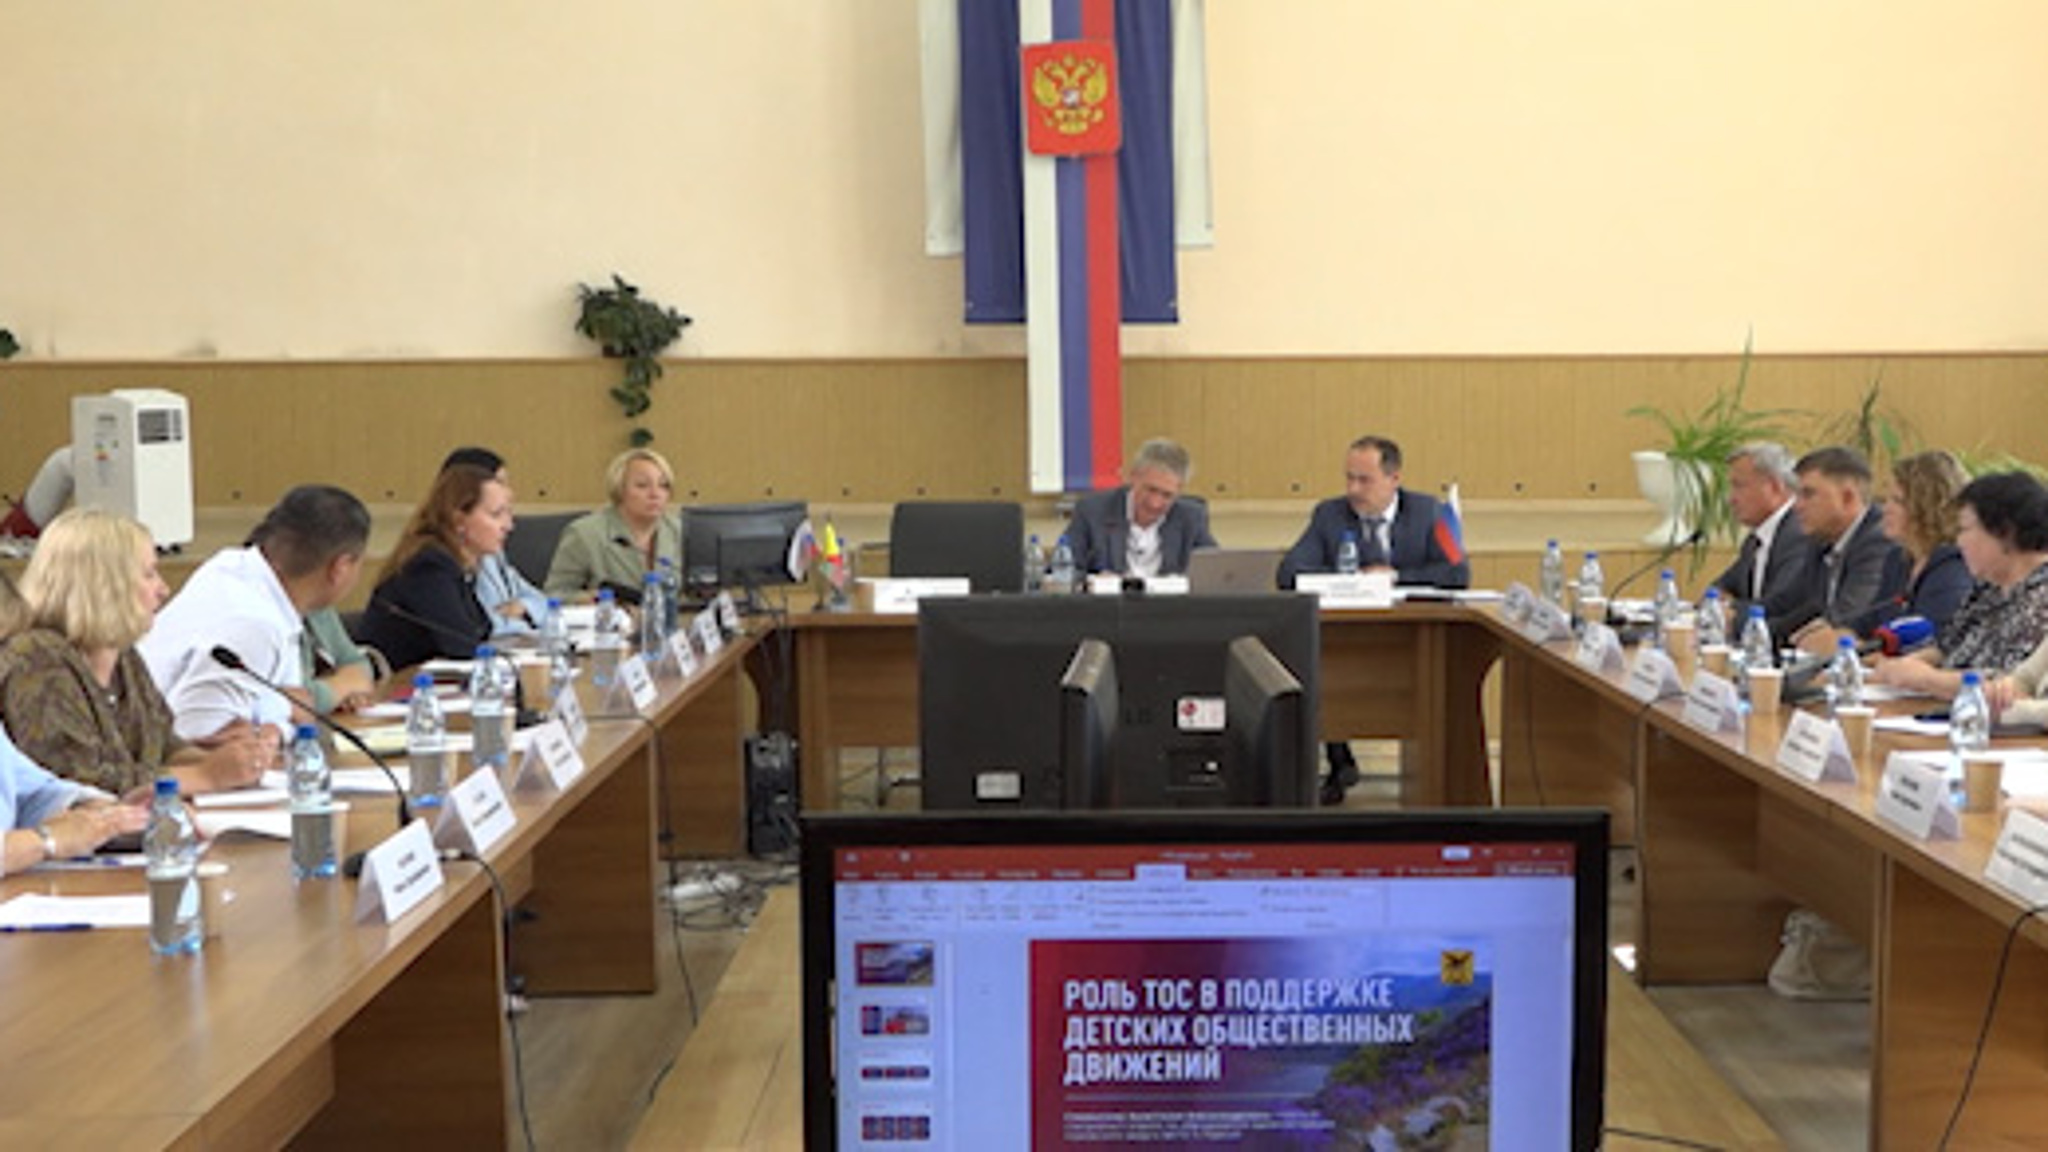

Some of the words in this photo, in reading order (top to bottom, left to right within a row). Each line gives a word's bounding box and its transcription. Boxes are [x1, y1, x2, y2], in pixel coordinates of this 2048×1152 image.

[1064, 979, 1136, 1010] РОЛЬ
[1143, 979, 1192, 1010] ТОС
[1200, 979, 1217, 1010] В
[1225, 978, 1394, 1012] ПОДДЕРЖКЕ
[1063, 1015, 1187, 1050] ДЕТСКИХ
[1193, 1014, 1414, 1048] ОБЩЕСТВЕННЫХ
[1063, 1046, 1222, 1086] ДВИЖЕНИЙ
